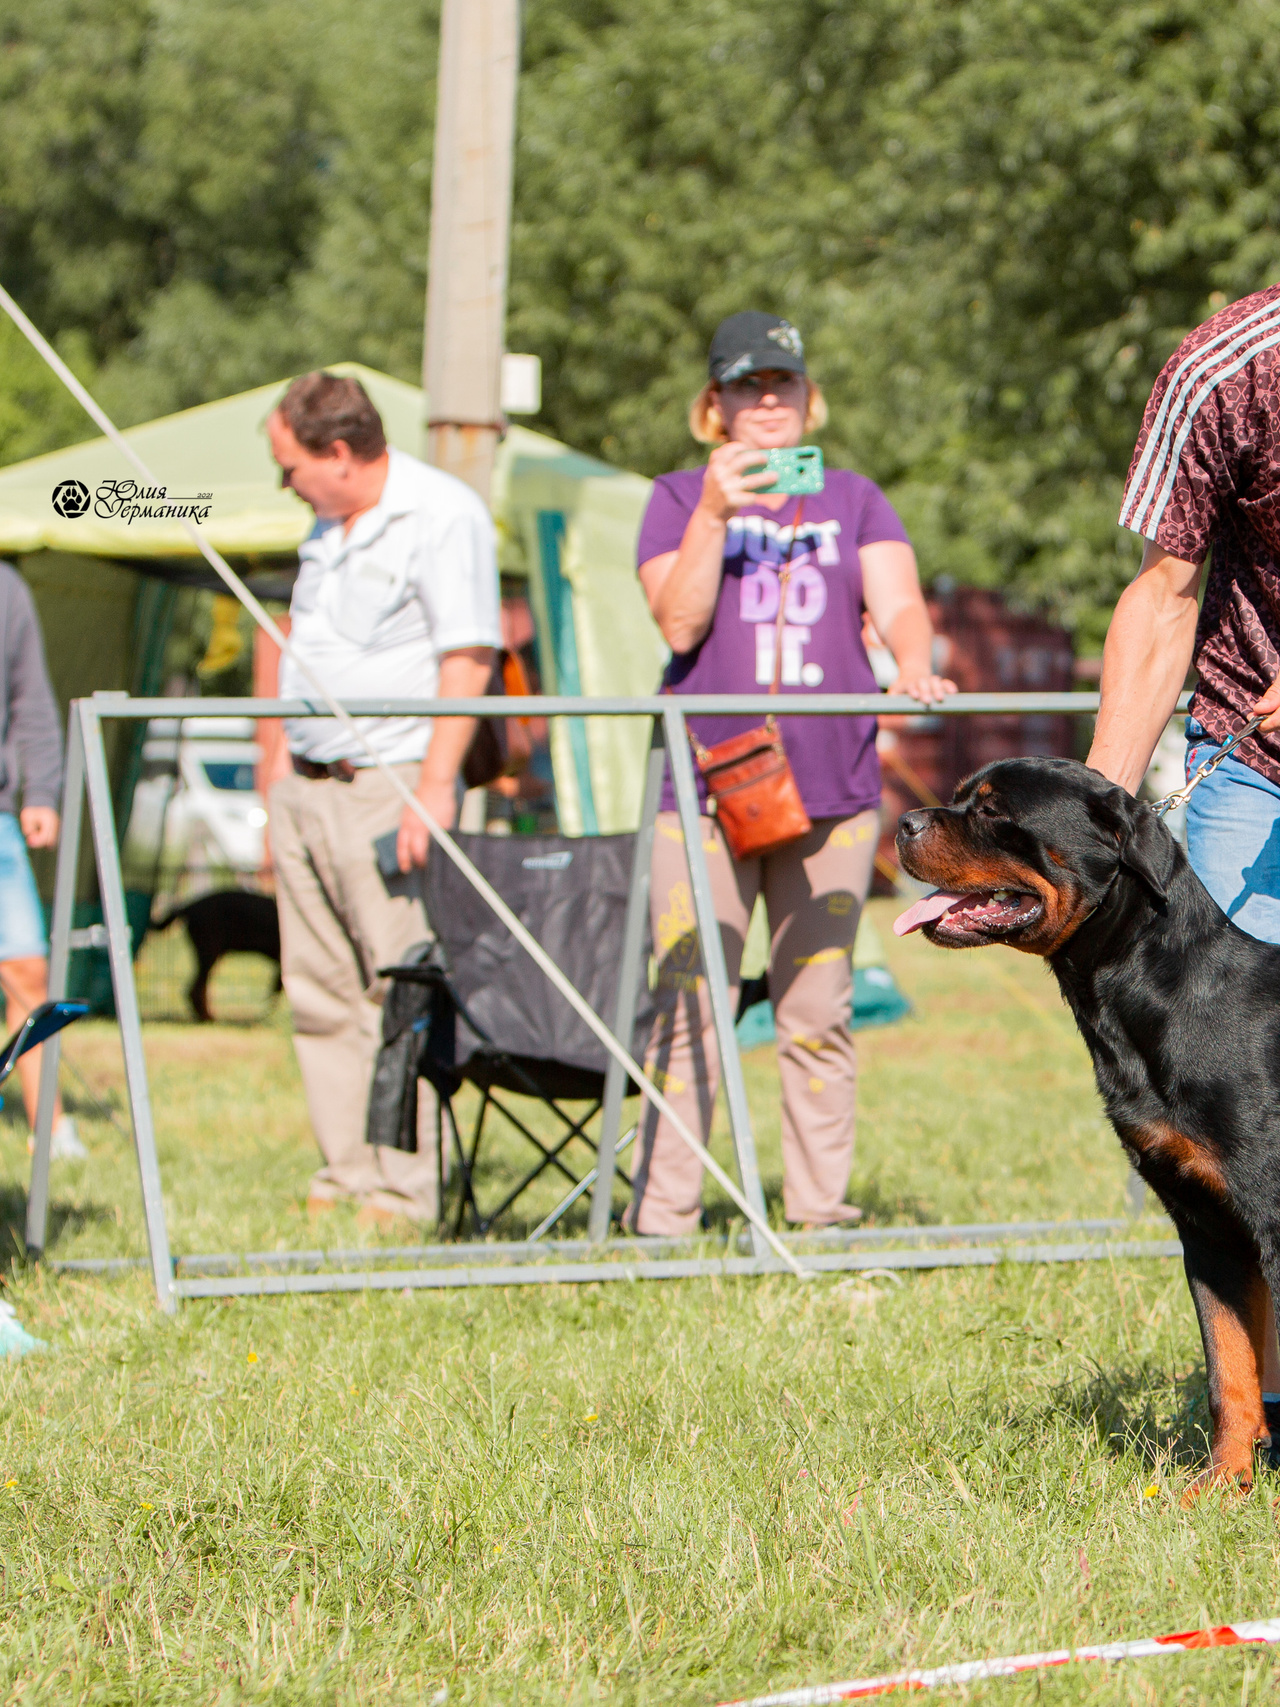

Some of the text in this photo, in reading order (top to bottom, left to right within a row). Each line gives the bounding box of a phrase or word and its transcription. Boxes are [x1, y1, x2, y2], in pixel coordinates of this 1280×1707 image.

[724, 515, 841, 566] JUST
[740, 560, 827, 626] DO
[755, 623, 824, 687] IT.
